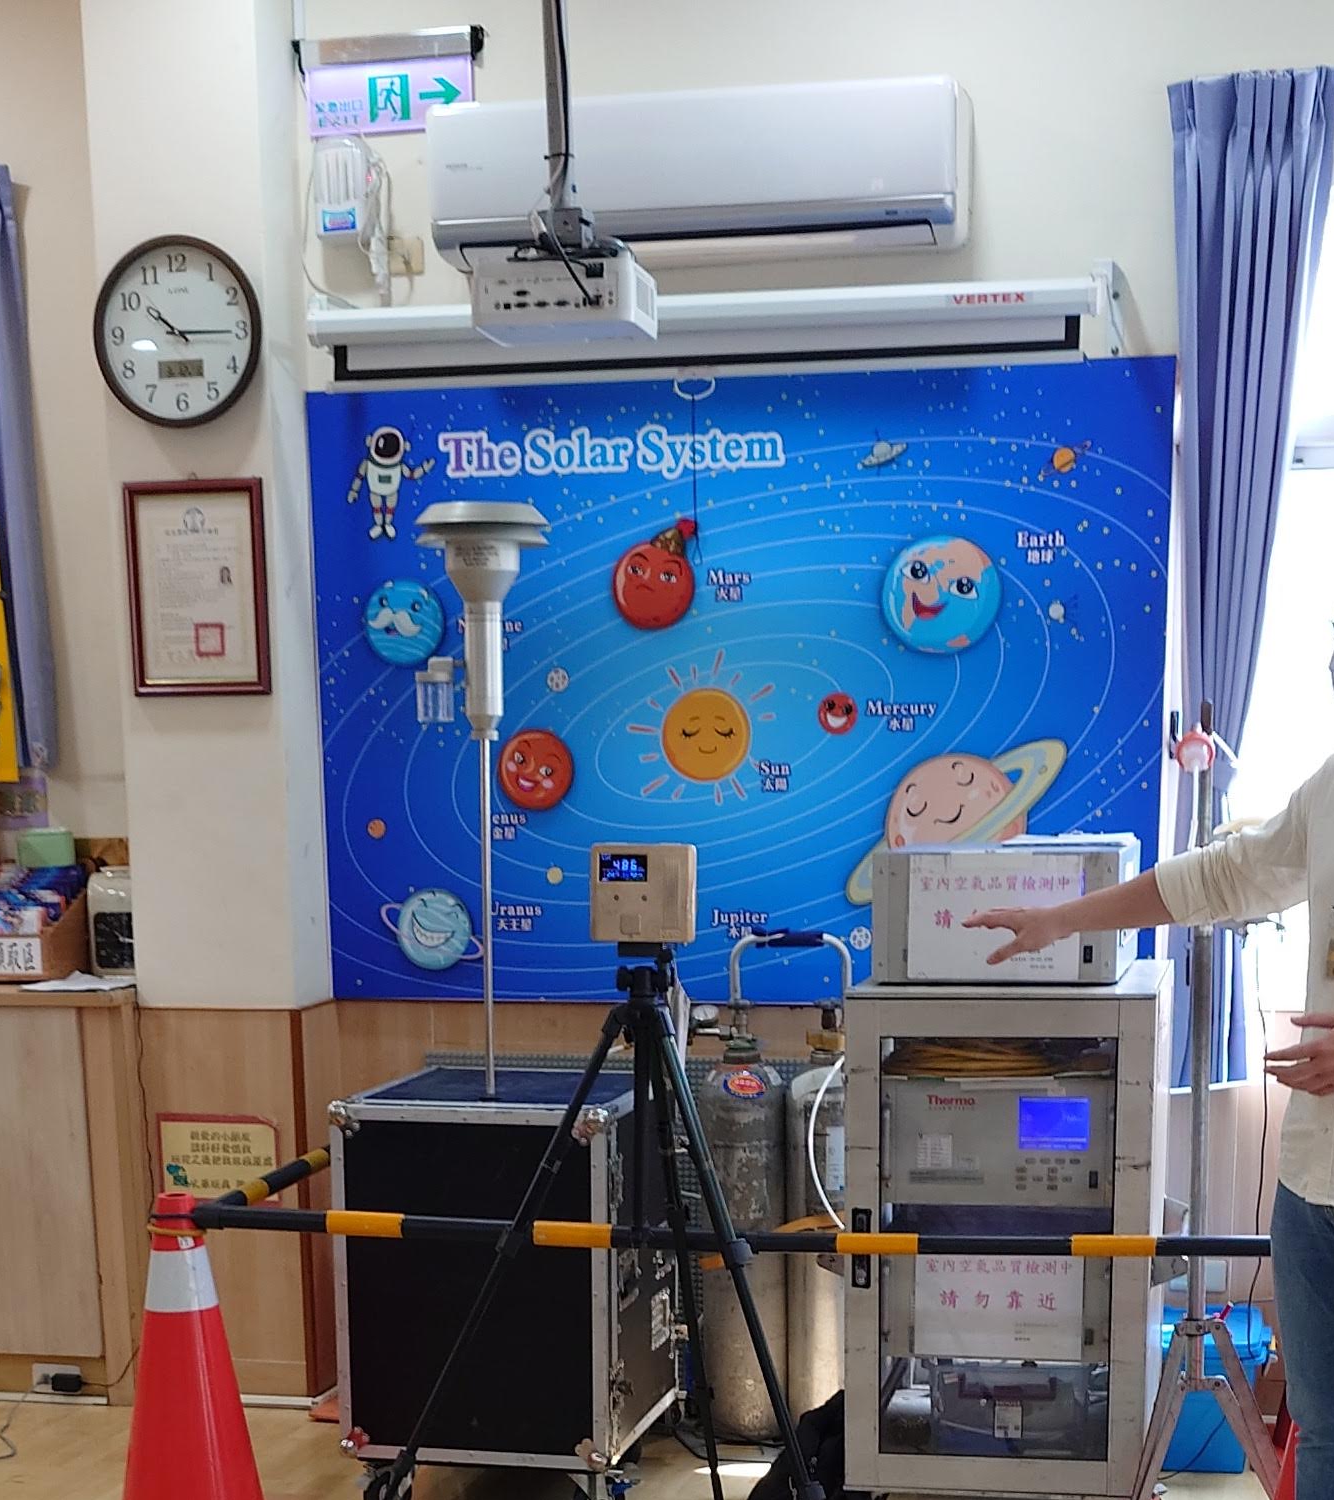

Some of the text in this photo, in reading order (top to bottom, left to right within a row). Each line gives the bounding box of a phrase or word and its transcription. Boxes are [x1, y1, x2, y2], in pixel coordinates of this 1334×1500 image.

[315, 99, 363, 114] 緊急出口
[318, 116, 360, 128] EXIT
[166, 253, 187, 273] 12
[206, 262, 215, 282] 1
[140, 266, 159, 285] 11
[120, 292, 141, 312] 10
[225, 287, 239, 306] 2
[953, 292, 1026, 305] VERTEX
[111, 326, 125, 346] 9
[235, 319, 249, 340] 3
[122, 360, 136, 380] 8
[226, 355, 240, 374] 4
[145, 384, 157, 403] 7
[206, 382, 220, 402] 5
[175, 393, 190, 412] 6
[441, 429, 782, 475] The Solar System
[1017, 530, 1065, 548] Earth
[1027, 549, 1054, 564] 地球
[708, 568, 750, 586] Mars
[867, 699, 937, 718] Mercury
[888, 717, 914, 732] 水星
[759, 760, 790, 776] Sun
[762, 777, 788, 792] 太陽
[492, 812, 527, 826] enus
[492, 826, 516, 840] 金星
[612, 858, 638, 872] 486
[920, 875, 1071, 893] 室內空氣品質檢測中
[497, 918, 532, 932] 天王星
[711, 909, 768, 927] Jupiter
[926, 1094, 976, 1106] Thermo
[925, 1258, 1073, 1276] 室內空氣品質檢測中
[939, 1288, 1057, 1312] 請勿靠近
